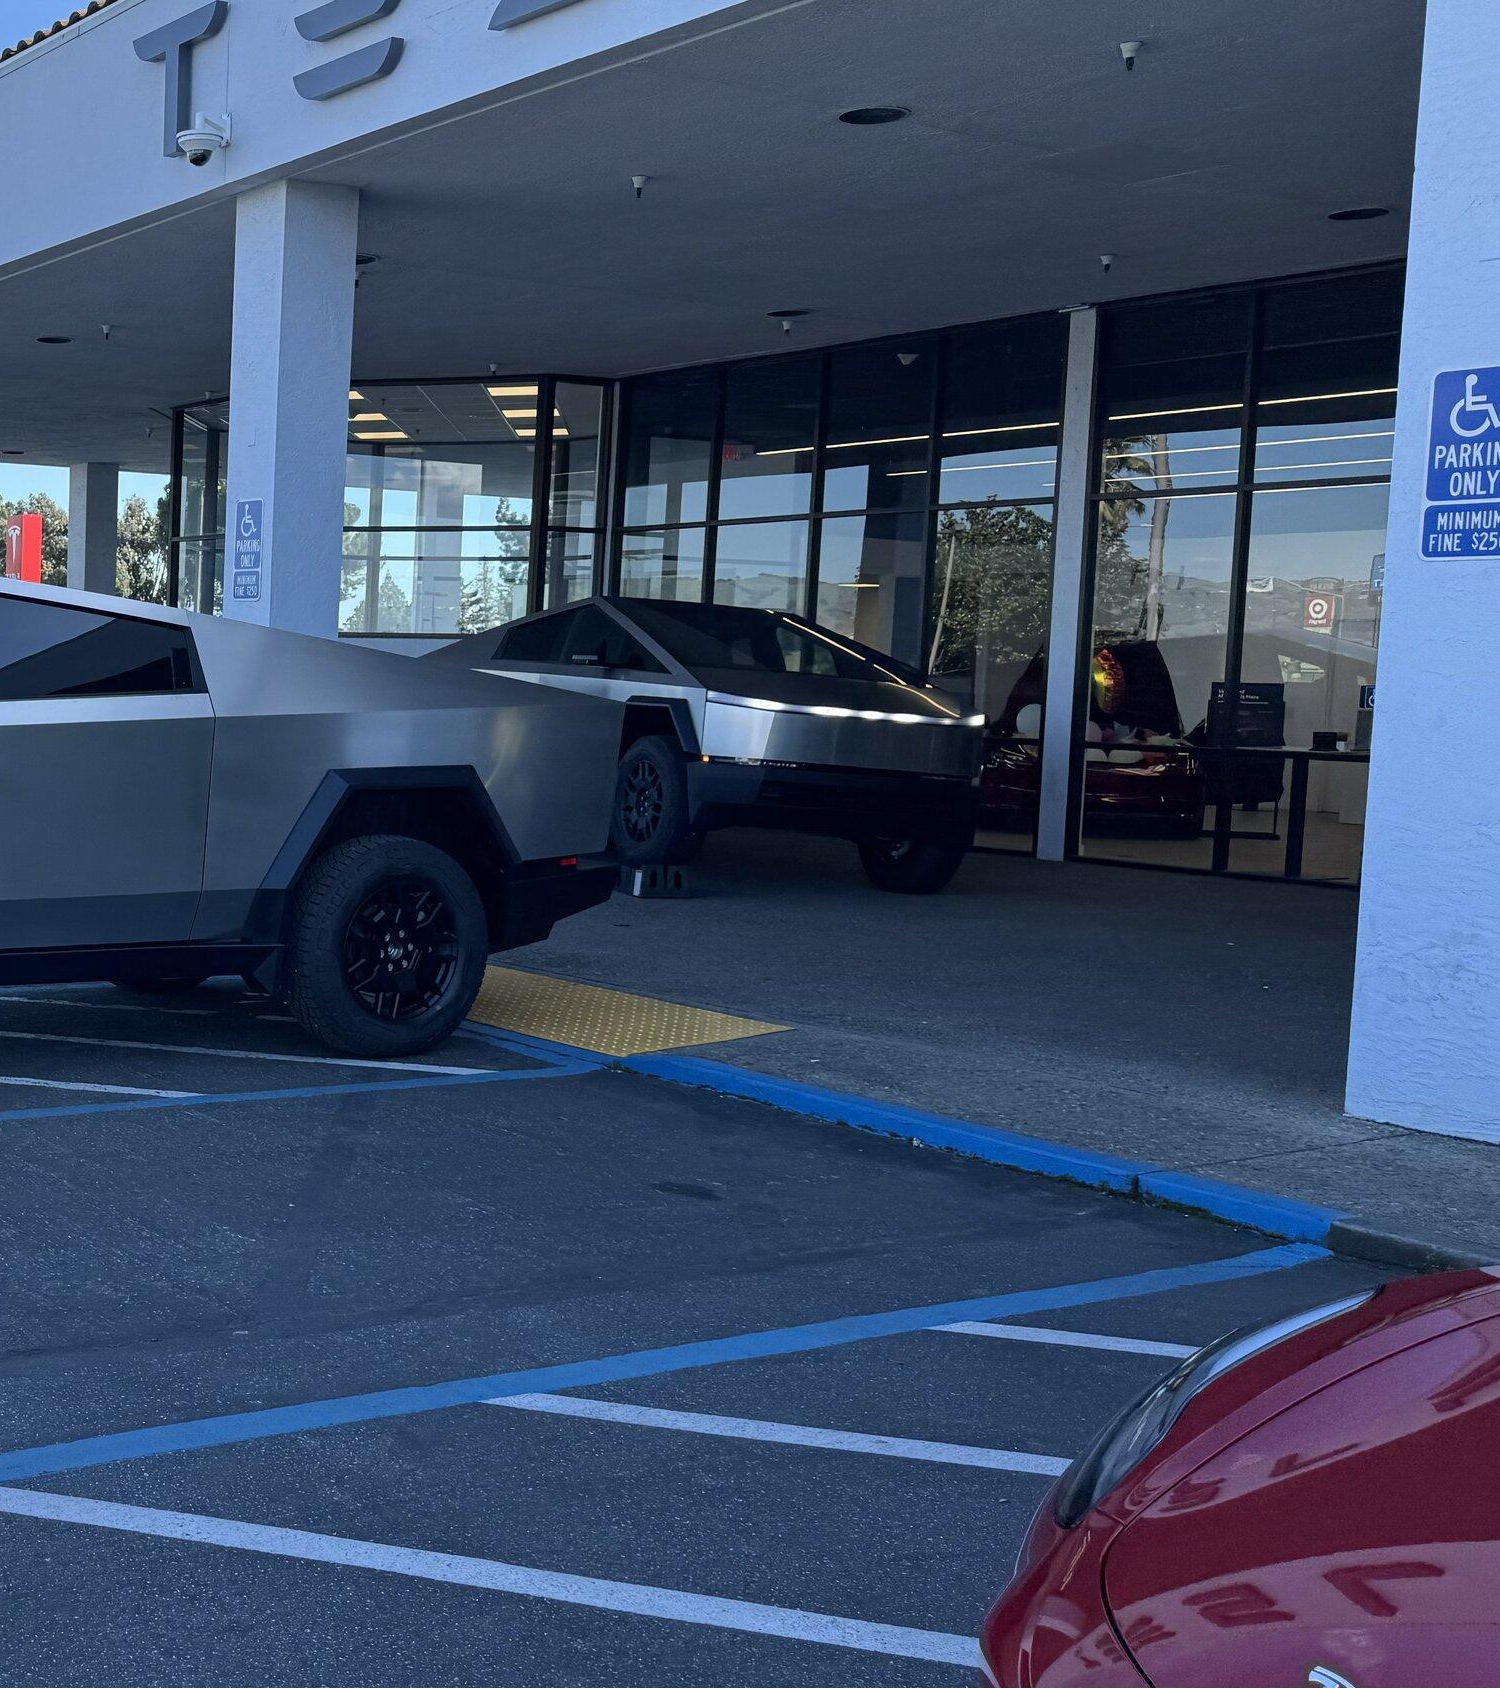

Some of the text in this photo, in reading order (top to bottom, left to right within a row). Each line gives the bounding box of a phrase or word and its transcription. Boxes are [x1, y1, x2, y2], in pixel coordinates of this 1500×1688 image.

[1449, 470, 1500, 496] ONLY
[1437, 510, 1500, 531] MINIMUM
[236, 539, 260, 553] PARKING
[1428, 531, 1500, 552] FINE $25
[241, 554, 255, 567] ONLY
